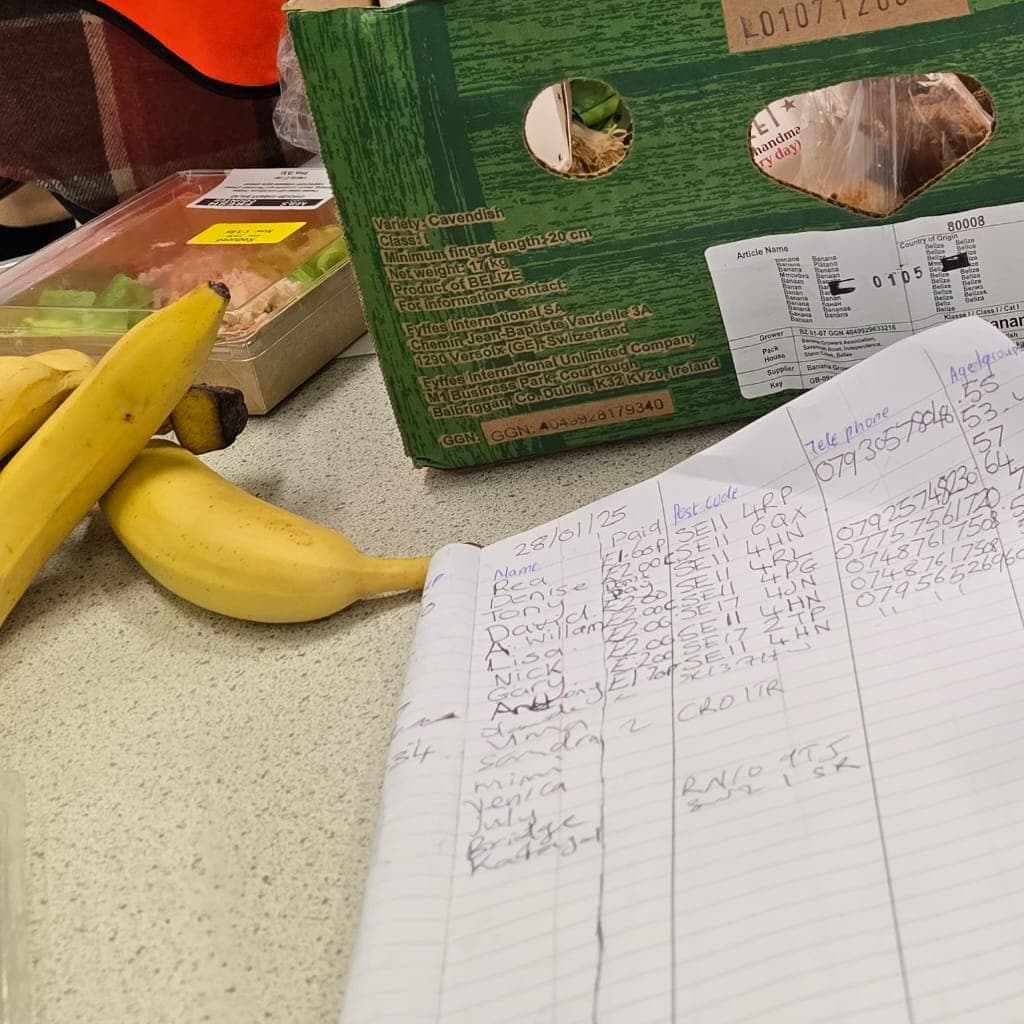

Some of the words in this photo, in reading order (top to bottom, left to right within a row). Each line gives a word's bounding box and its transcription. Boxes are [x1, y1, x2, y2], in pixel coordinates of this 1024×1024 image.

[752, 126, 801, 157] handma
[374, 218, 425, 232] Variety:
[428, 207, 504, 227] Cavendish
[947, 215, 986, 232] 80008
[384, 250, 446, 264] Minimum
[448, 243, 491, 259] finger
[569, 229, 592, 241] cm
[736, 247, 763, 260] Article
[764, 245, 790, 255] Name
[900, 238, 926, 249] Country
[936, 233, 959, 243] Origin
[389, 266, 412, 279] Net
[415, 263, 465, 281] weight:
[469, 260, 485, 272] 17
[490, 257, 509, 270] kg
[394, 282, 448, 296] Product
[450, 279, 466, 291] of
[468, 270, 522, 288] BELIZE
[399, 300, 424, 312] For
[424, 290, 506, 310] information
[508, 279, 567, 298] contact:
[406, 323, 448, 337] Fyffes
[450, 308, 542, 332] International
[543, 303, 566, 316] SA
[975, 308, 995, 316] Class
[410, 338, 464, 352] Chemin
[466, 319, 567, 345] Jean-Baptiste
[566, 310, 629, 327] Vandelle
[632, 305, 652, 318] 3A
[759, 330, 785, 342] Grower
[416, 354, 448, 366] 1290
[449, 346, 507, 362] Versoix
[547, 325, 630, 347] Switzerland
[762, 345, 779, 355] Pack
[423, 375, 466, 390] Fyffes
[469, 359, 558, 380] International
[560, 345, 628, 366] Unlimited
[630, 334, 698, 354] Company
[764, 353, 786, 363] House
[428, 392, 450, 403] M1
[451, 382, 518, 401] Business
[519, 376, 557, 389] Park,
[559, 360, 638, 382] Courtlough
[767, 365, 795, 377] Supplier
[434, 397, 512, 418] Balbriggan,
[515, 392, 542, 404] Co.
[543, 383, 595, 399] Dublin,
[595, 378, 624, 391] K32
[626, 370, 671, 386] KV20,
[671, 358, 720, 376] Ireland
[770, 380, 783, 389] Key
[443, 433, 480, 446] GGN:
[973, 425, 1004, 453] 57
[493, 562, 538, 581] Name
